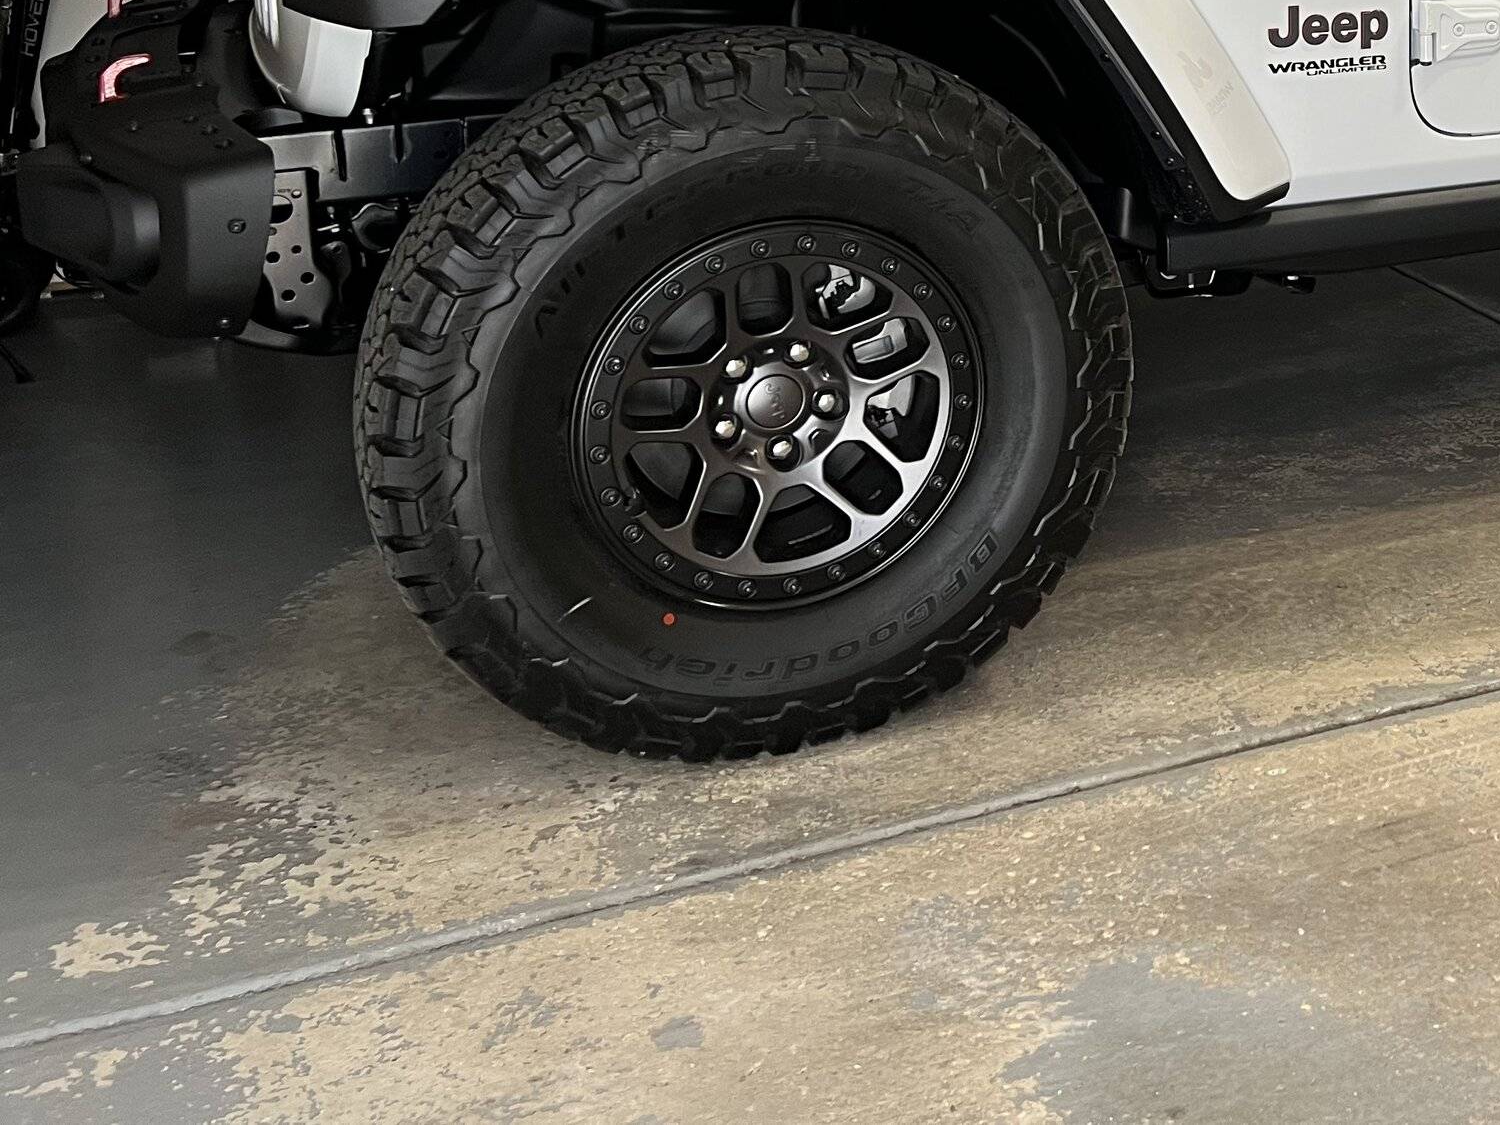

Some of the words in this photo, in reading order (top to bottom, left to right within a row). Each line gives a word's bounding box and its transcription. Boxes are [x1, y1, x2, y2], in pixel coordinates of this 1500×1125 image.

[1267, 5, 1389, 49] Jeep
[1267, 55, 1387, 74] WRANGLER
[1306, 64, 1387, 76] UNLIMITED
[640, 528, 1001, 684] BFGoodrich
